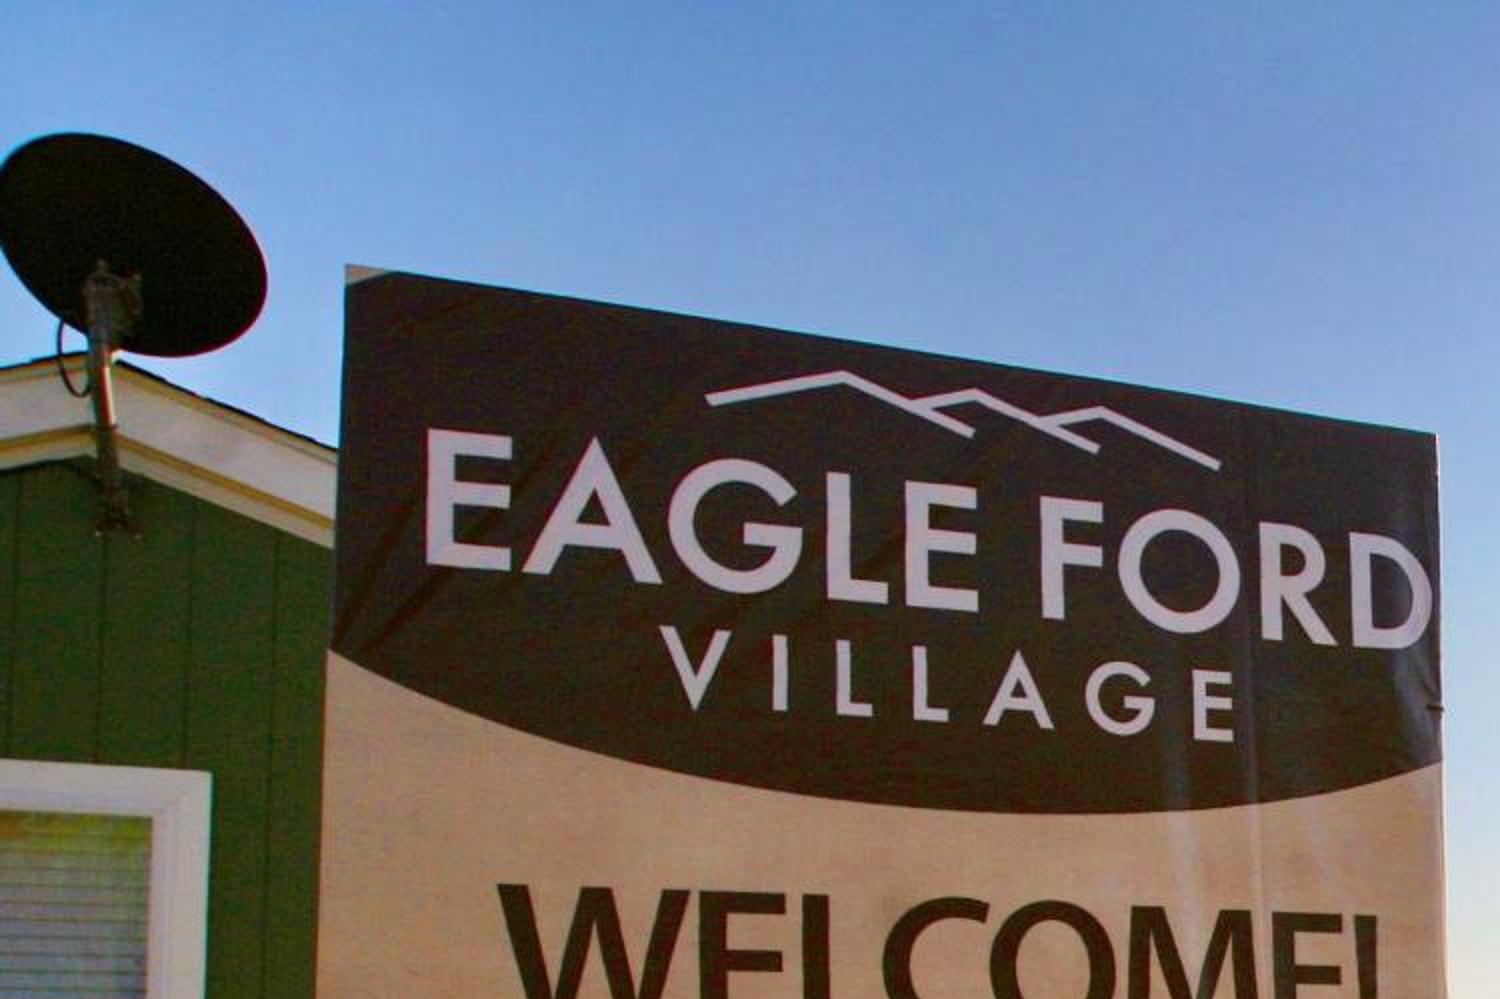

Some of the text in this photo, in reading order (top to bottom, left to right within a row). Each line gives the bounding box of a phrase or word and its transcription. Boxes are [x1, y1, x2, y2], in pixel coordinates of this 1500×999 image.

[425, 428, 1432, 650] EAGLE FORD
[659, 625, 1235, 742] VILLAGE
